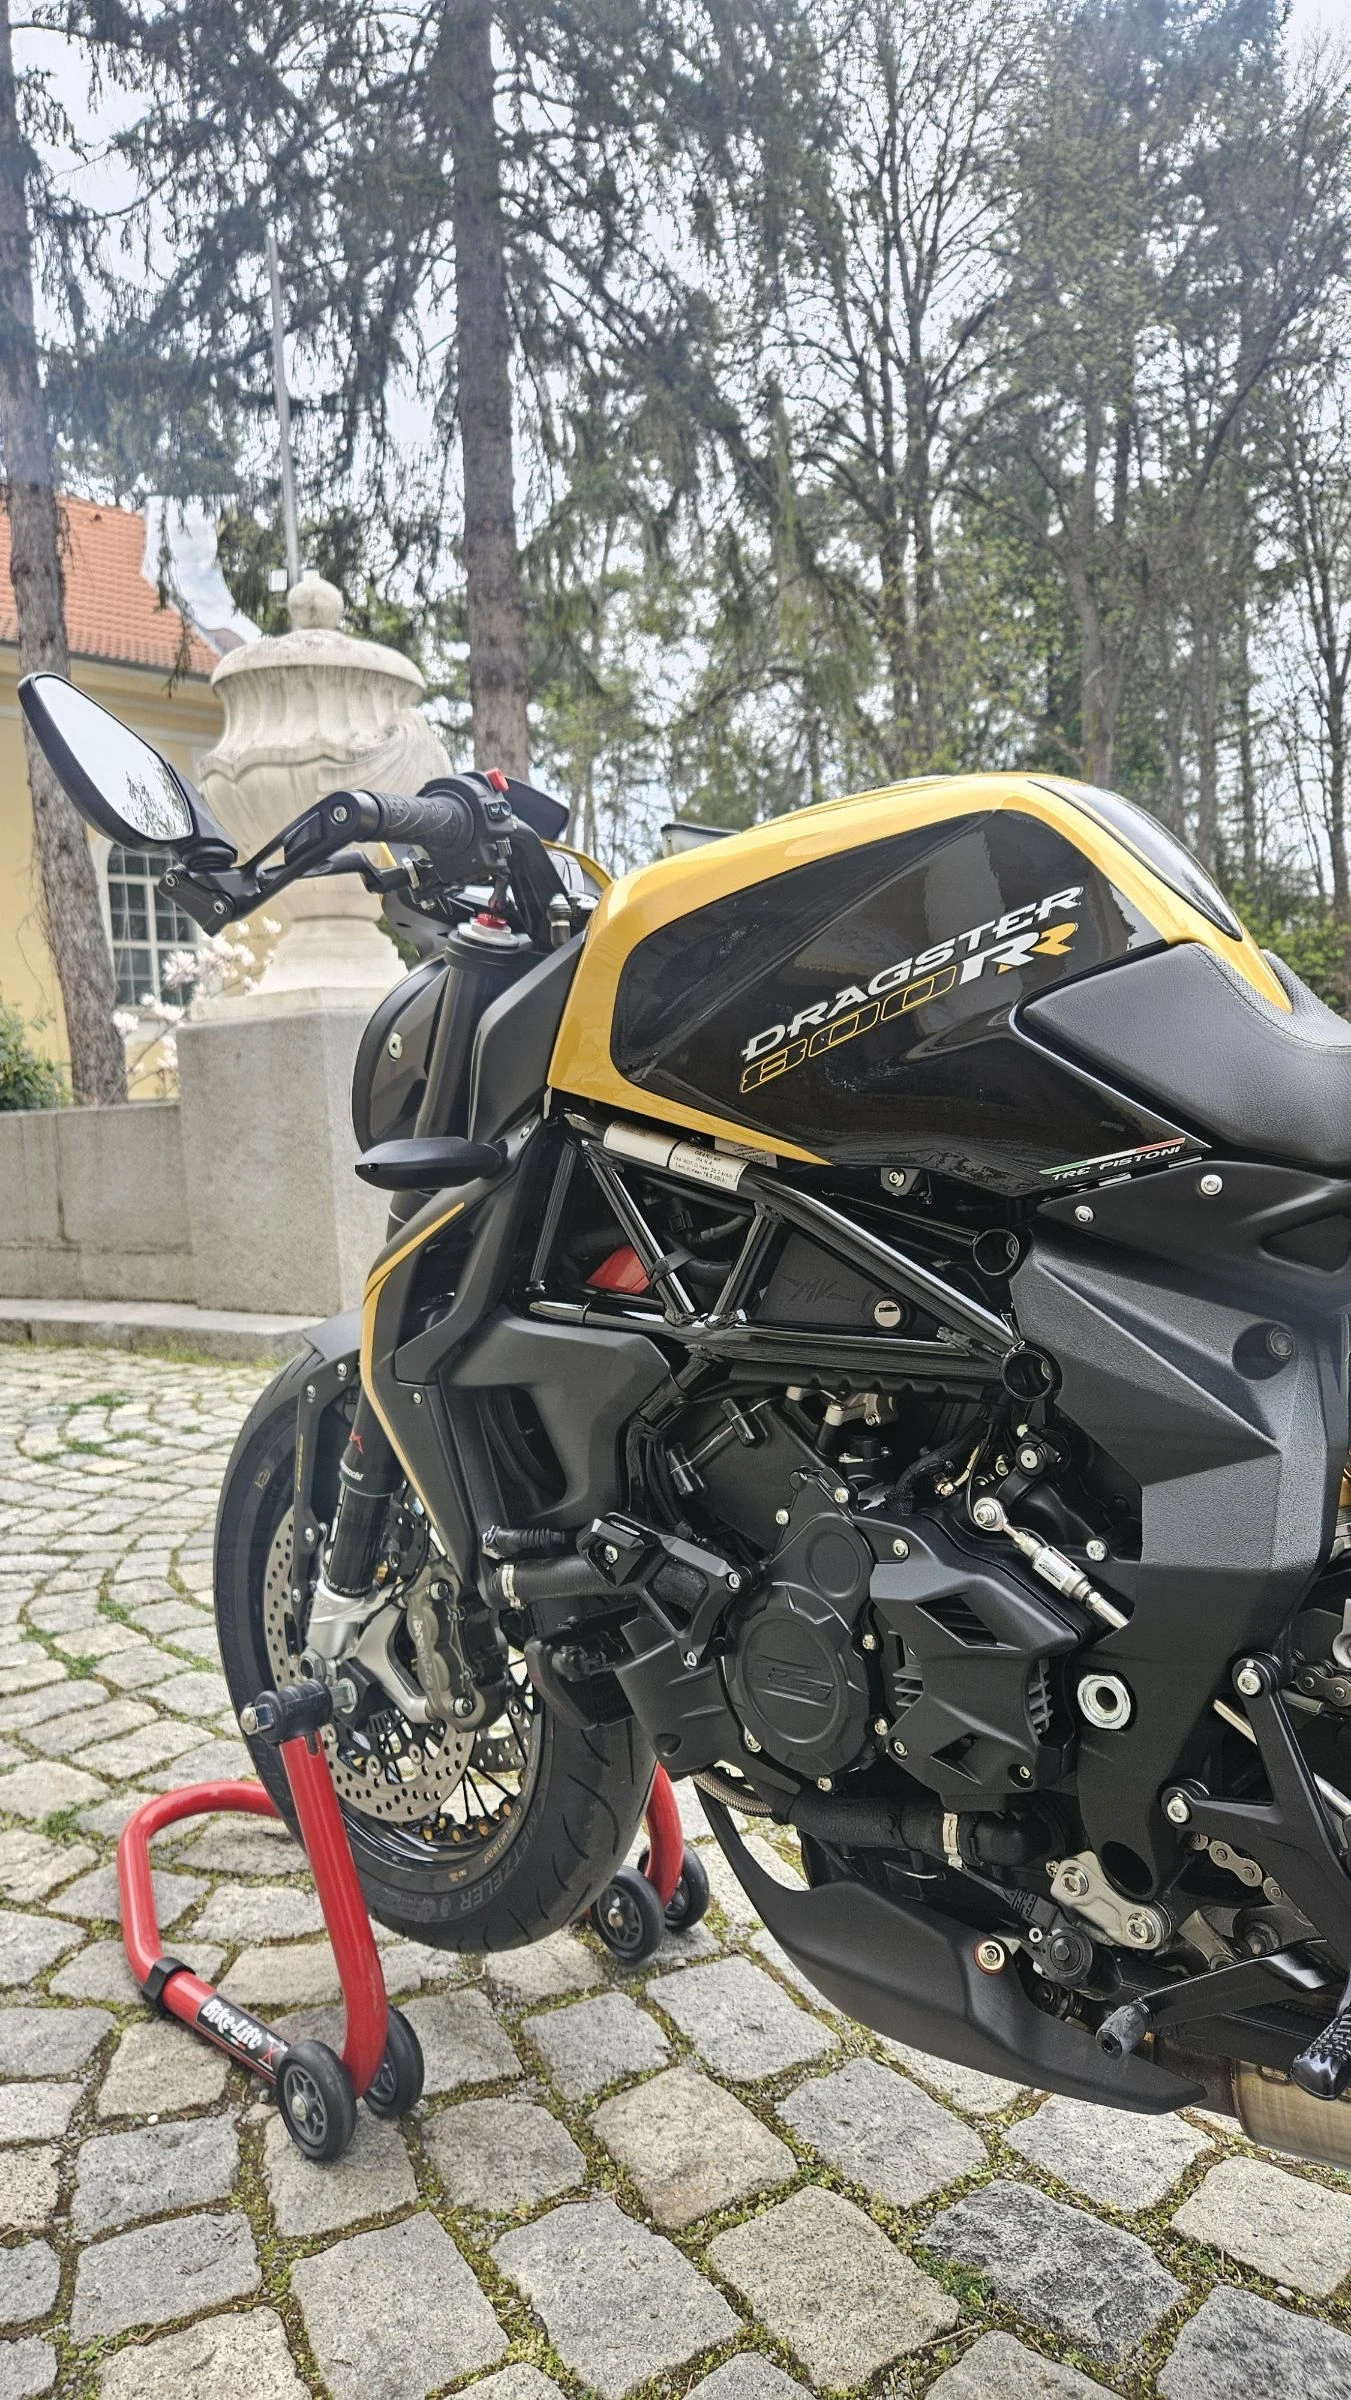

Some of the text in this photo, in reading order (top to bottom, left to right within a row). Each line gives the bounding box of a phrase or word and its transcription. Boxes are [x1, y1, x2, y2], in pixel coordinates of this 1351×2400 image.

[741, 886, 1084, 1062] DRAGSTER
[1052, 1145, 1182, 1181] TRE PISTONI
